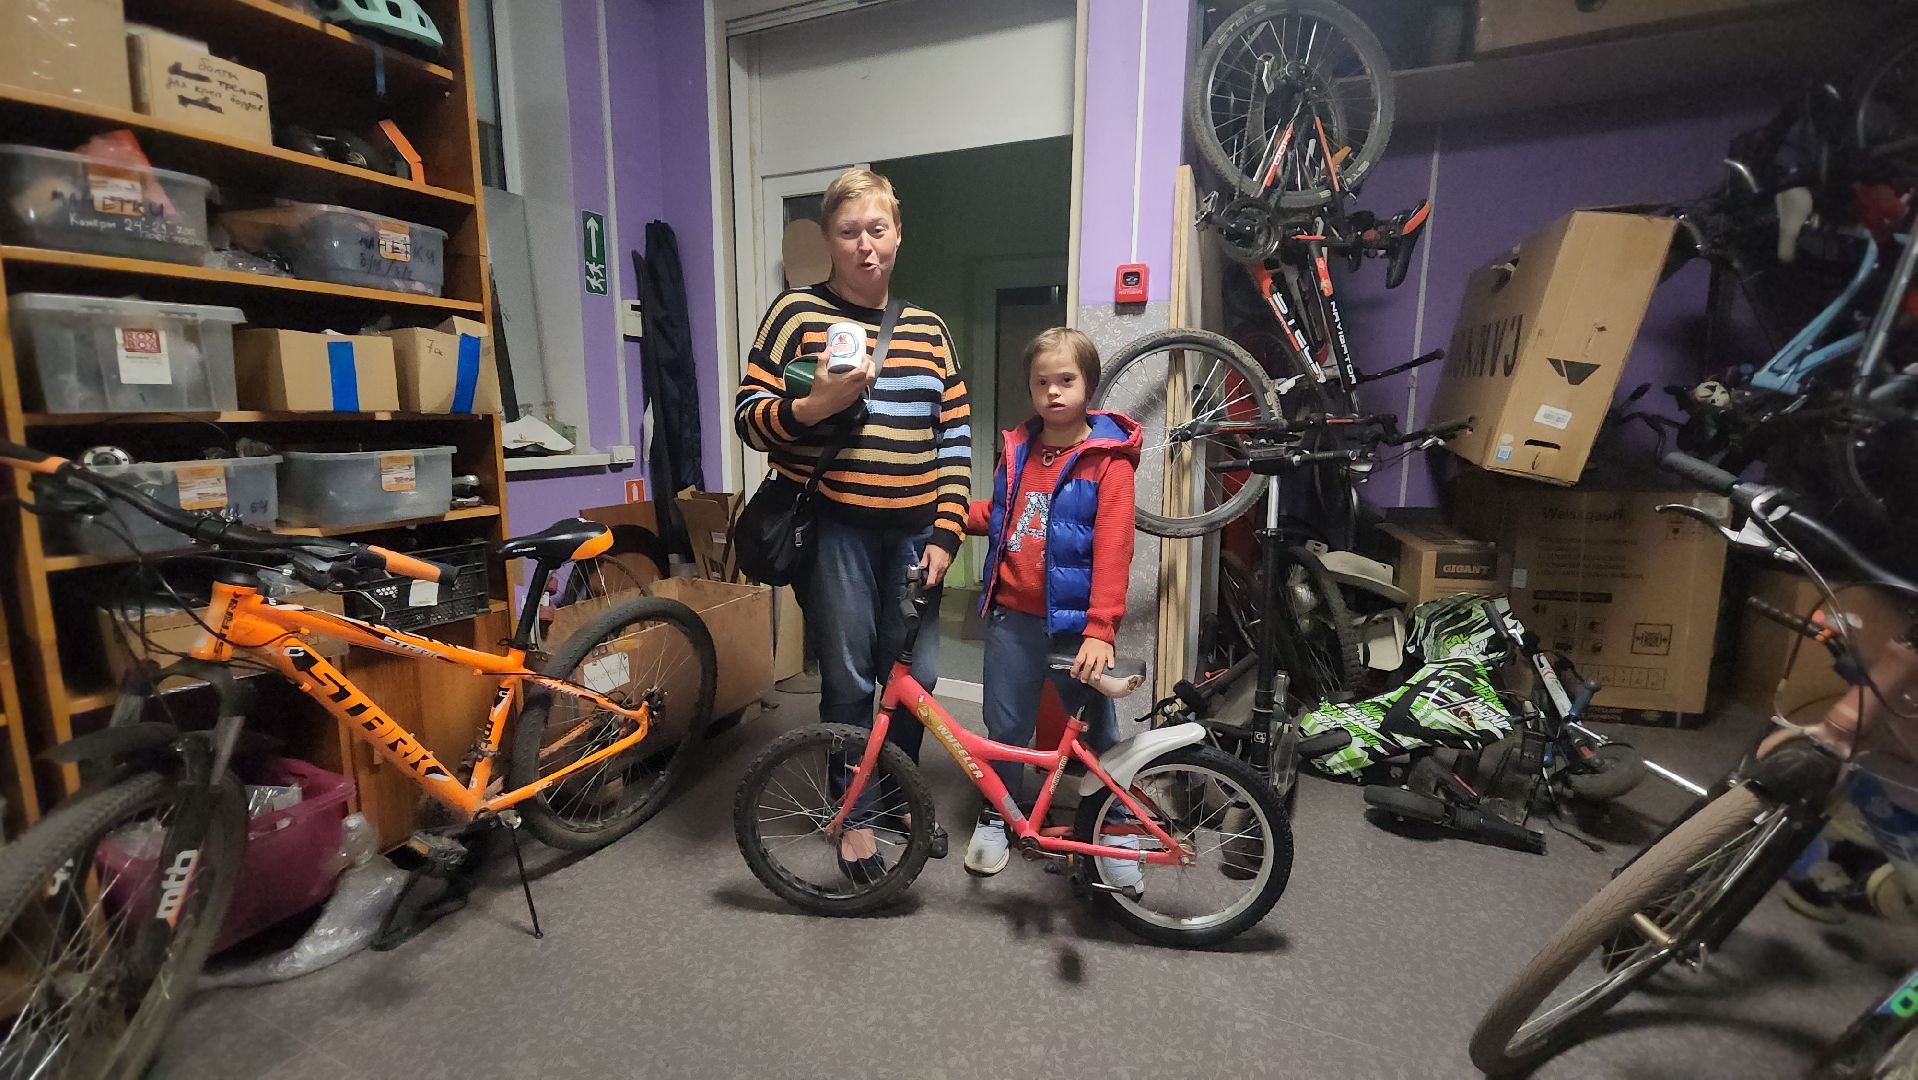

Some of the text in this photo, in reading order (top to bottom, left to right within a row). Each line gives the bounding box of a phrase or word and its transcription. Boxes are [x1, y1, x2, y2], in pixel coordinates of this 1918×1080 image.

[1330, 300, 1357, 385] NAVIGATOR
[1442, 563, 1490, 575] GIGANT
[291, 655, 449, 780] STARK
[936, 723, 984, 779] WHEELER
[155, 849, 199, 919] mtb
